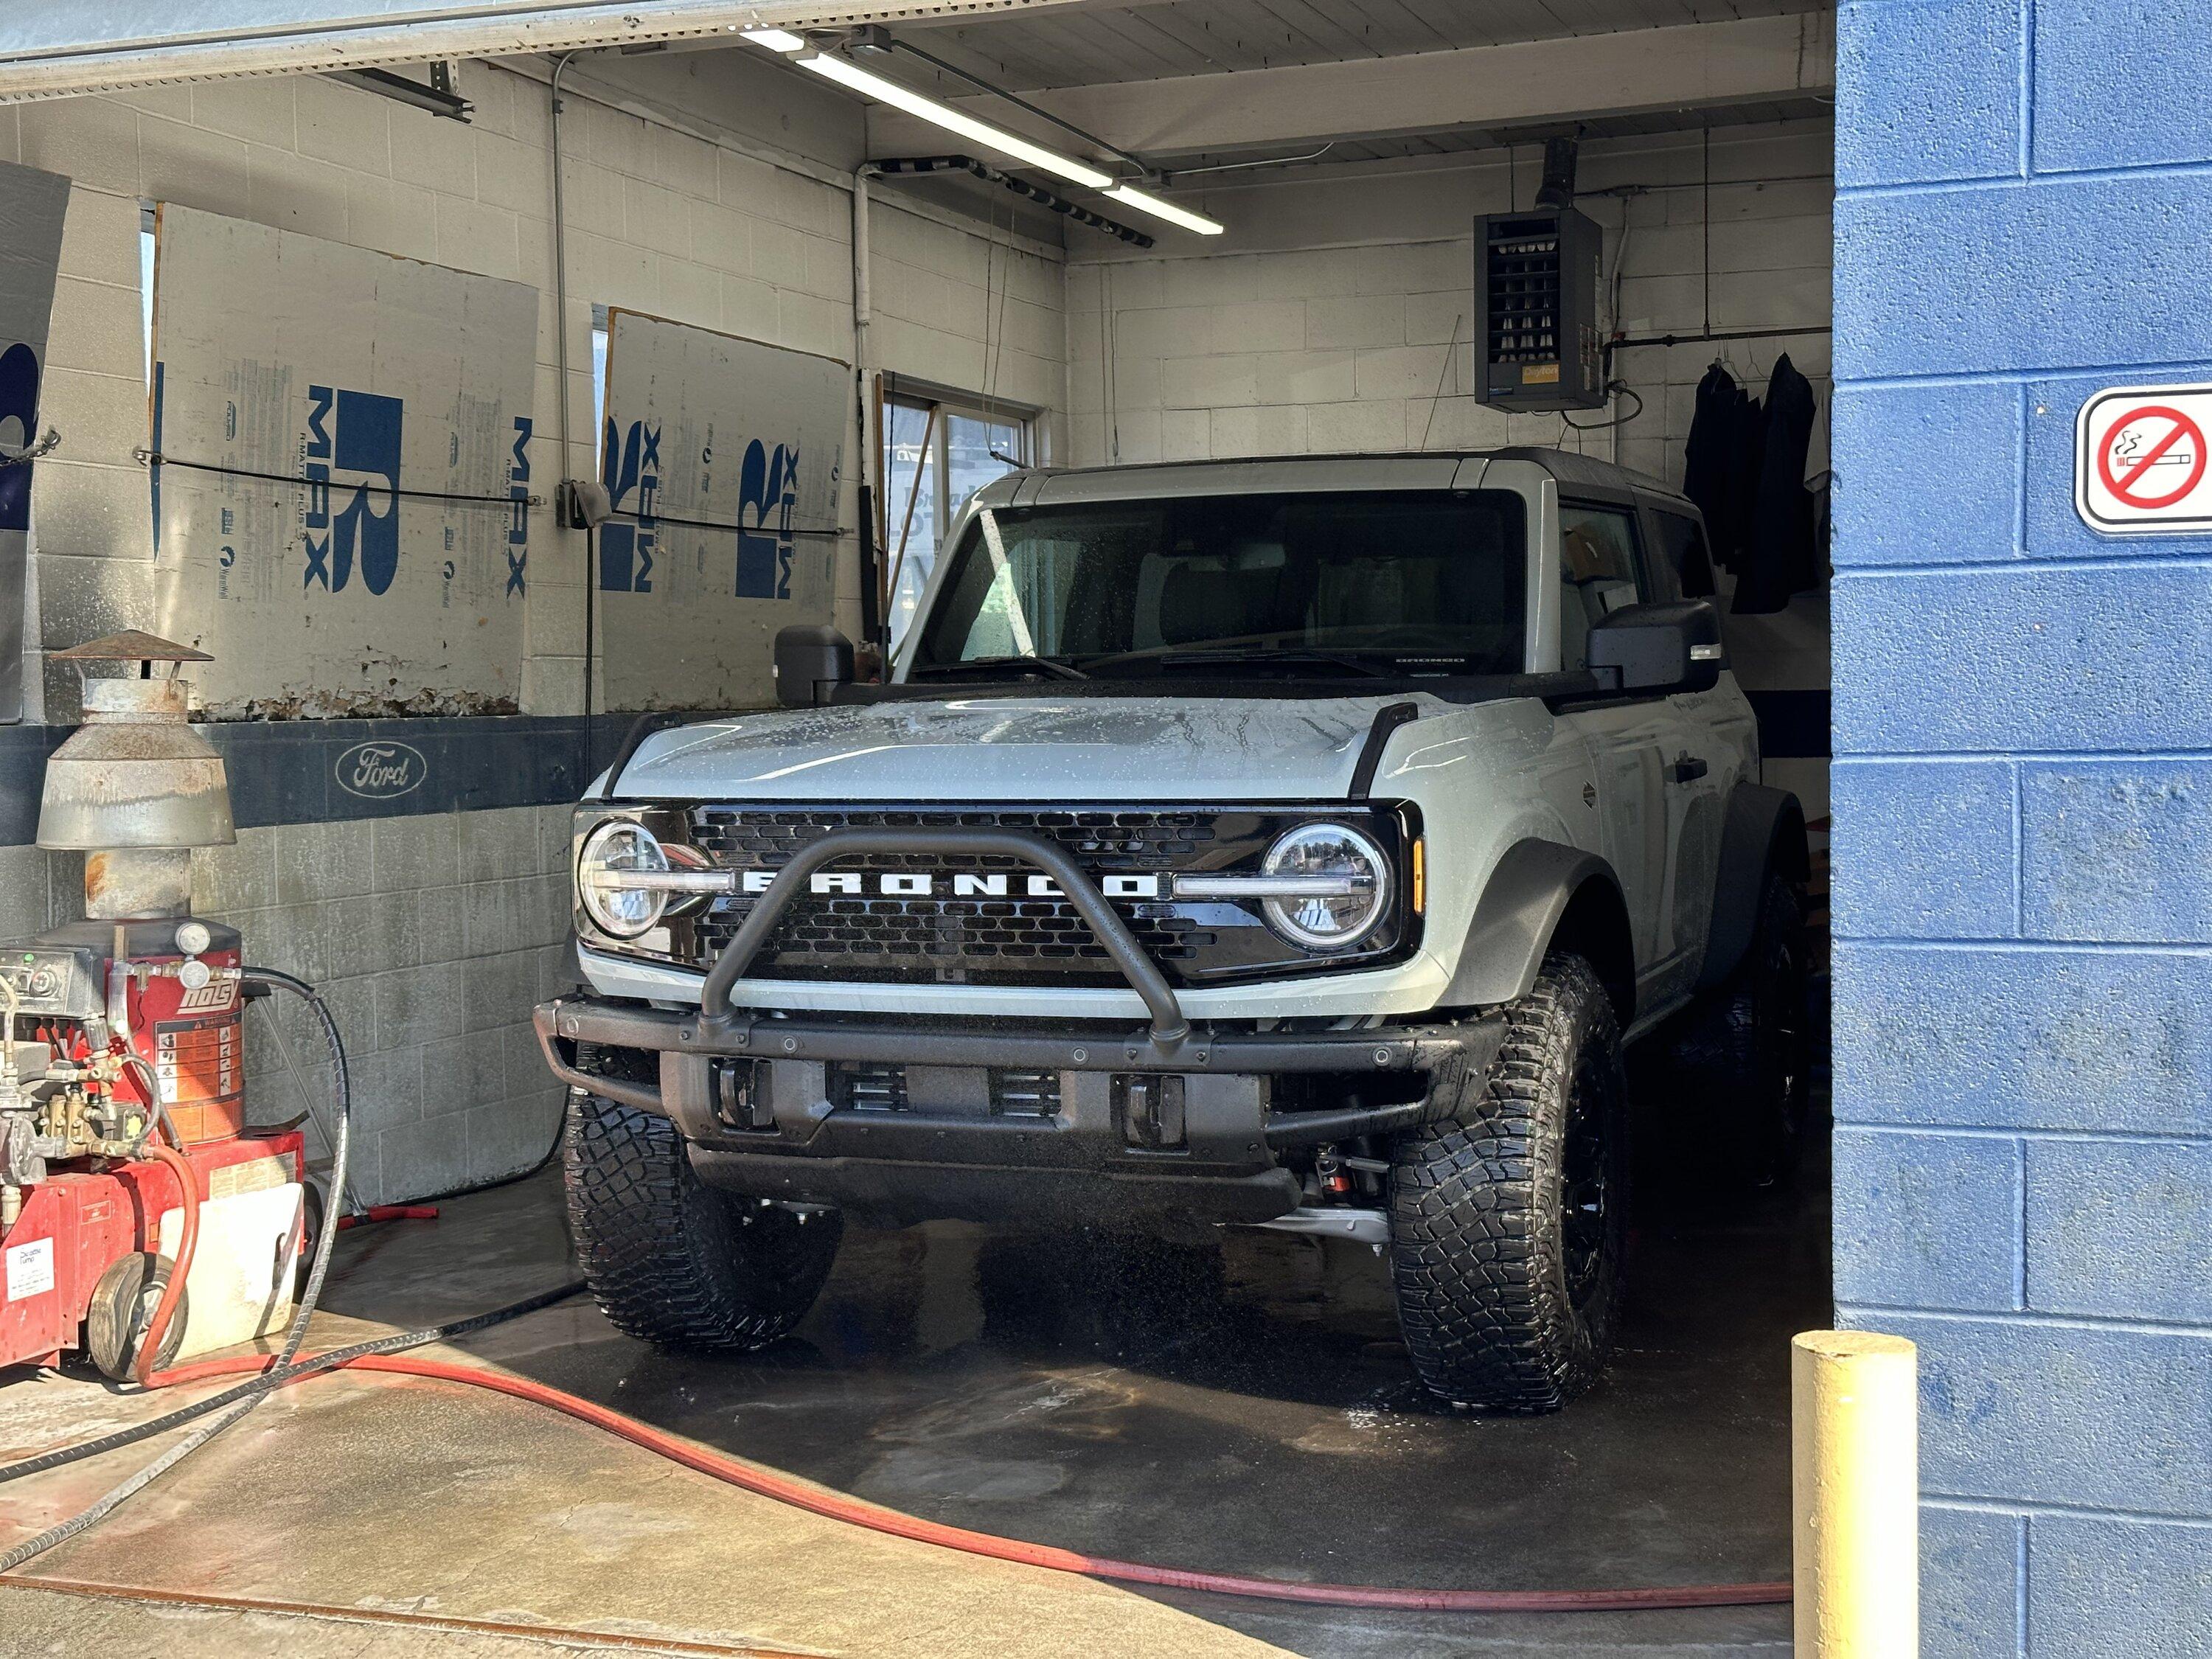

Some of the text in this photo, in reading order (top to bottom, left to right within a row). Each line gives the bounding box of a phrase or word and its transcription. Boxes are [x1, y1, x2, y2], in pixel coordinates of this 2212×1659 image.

[305, 385, 333, 591] MAX
[506, 417, 532, 600] MAX
[634, 422, 661, 593] MAX
[776, 446, 800, 599] MAX
[353, 748, 409, 787] Ford
